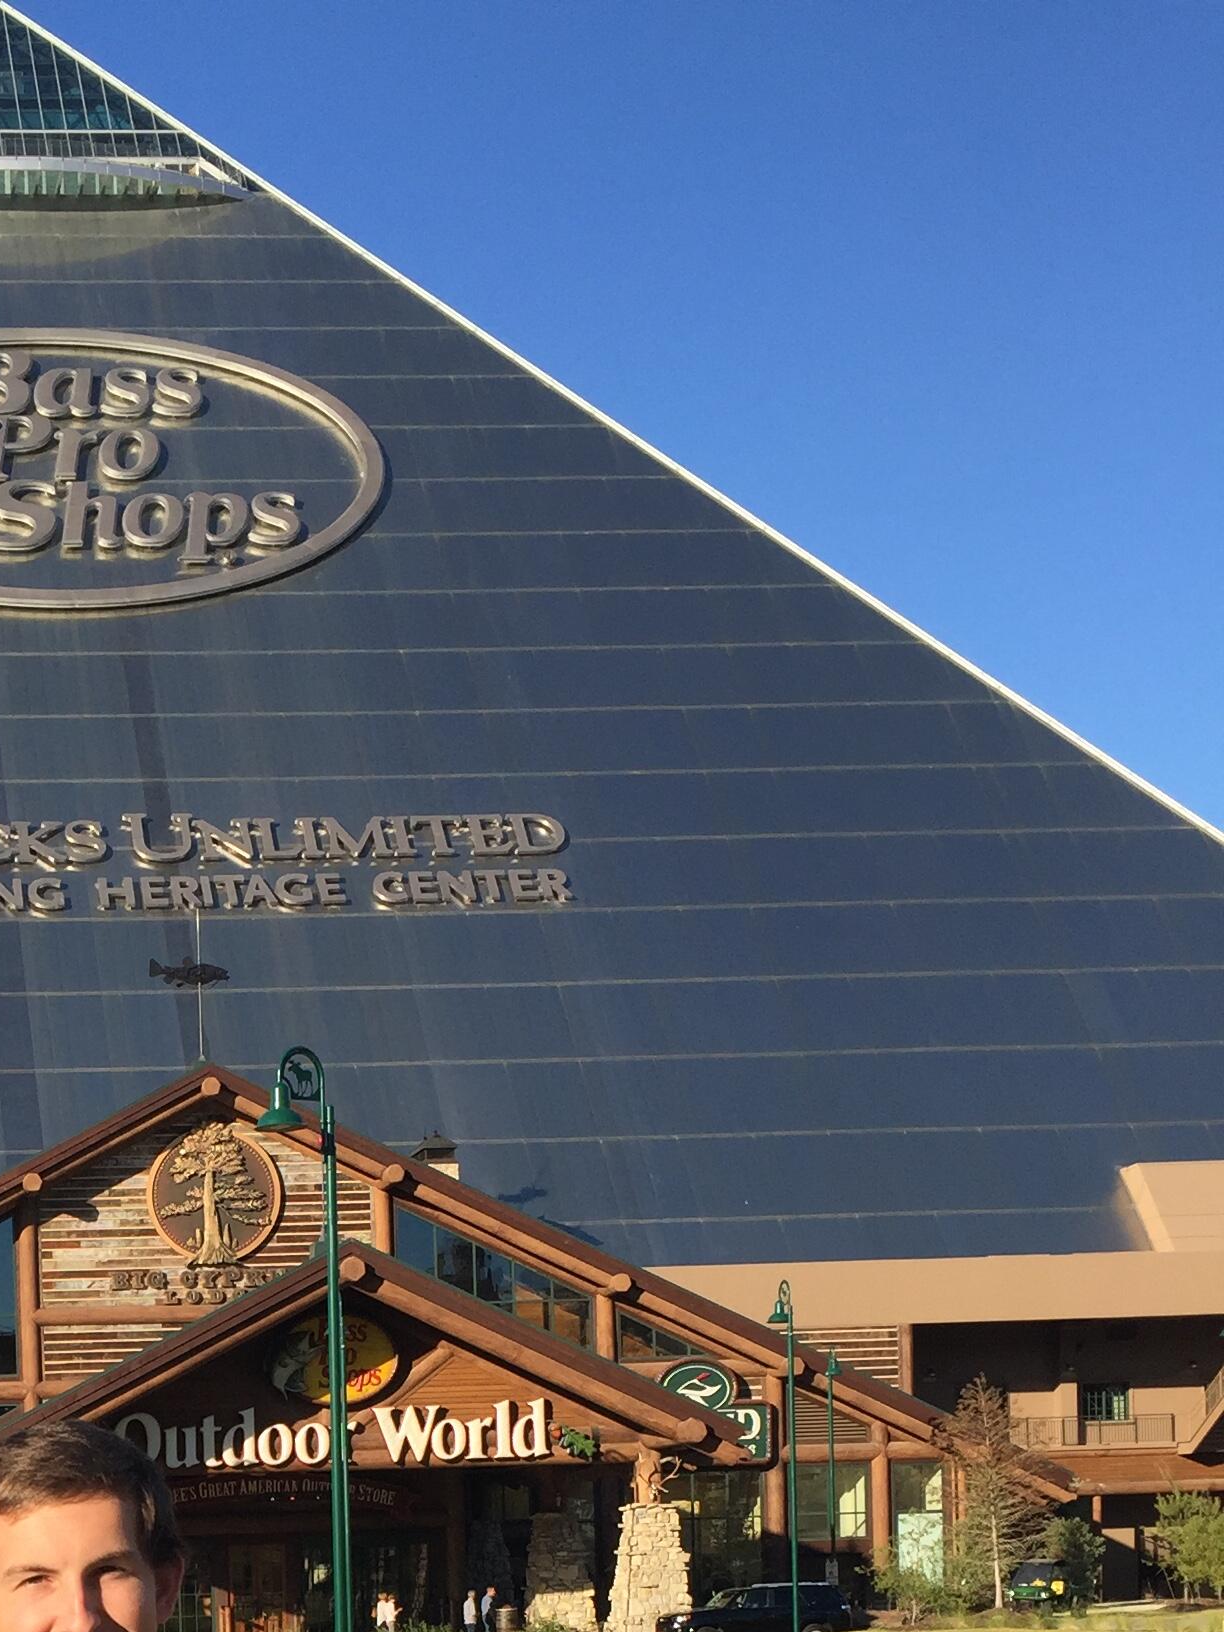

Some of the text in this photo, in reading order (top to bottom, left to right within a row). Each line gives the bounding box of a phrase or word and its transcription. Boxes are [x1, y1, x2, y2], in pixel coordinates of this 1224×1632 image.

[121, 812, 567, 864] UNLIMITED
[95, 872, 346, 910] HERITAGE
[372, 867, 572, 908] CENTER
[111, 1269, 279, 1290] BIG CYPR
[372, 1397, 551, 1463] World
